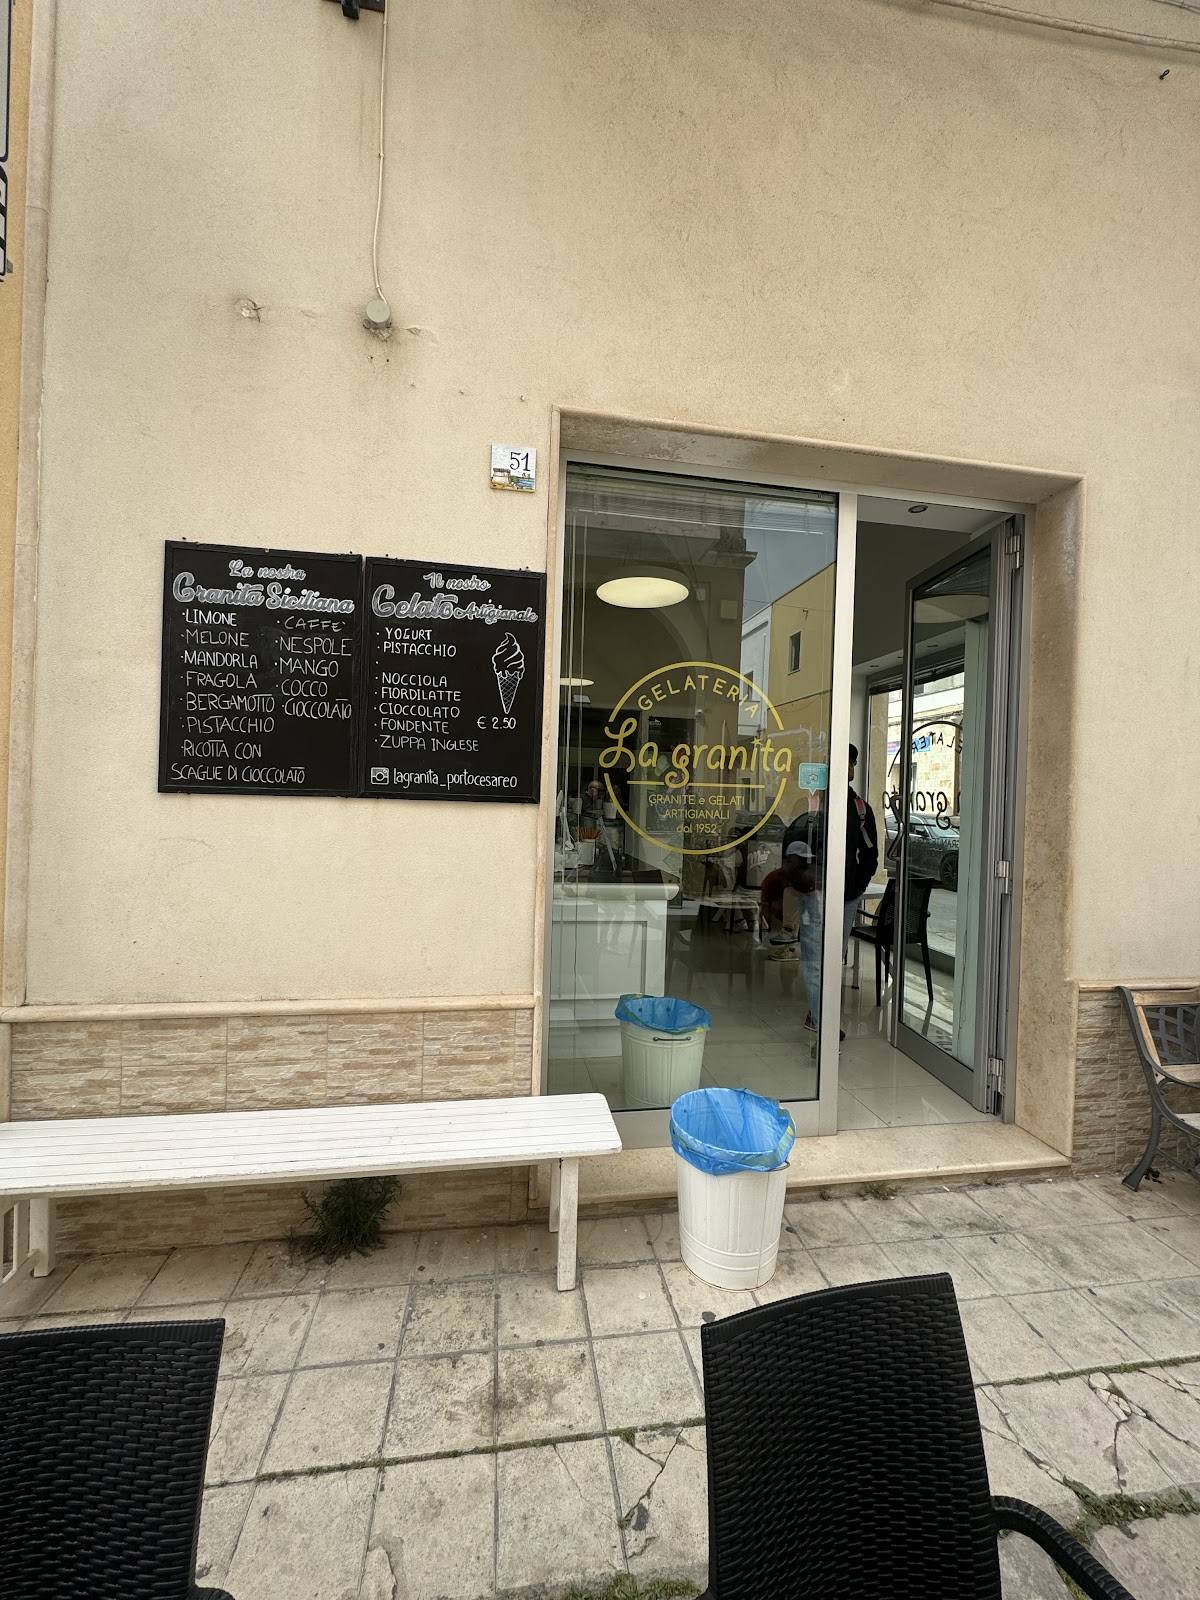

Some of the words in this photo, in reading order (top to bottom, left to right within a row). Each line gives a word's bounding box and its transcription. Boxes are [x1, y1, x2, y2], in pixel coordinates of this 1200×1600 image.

[510, 451, 531, 471] 51
[228, 559, 255, 578] La
[257, 563, 307, 581] nostra
[172, 571, 265, 606] Granita
[265, 582, 355, 613] Siciliana
[446, 575, 492, 591] nostro
[371, 583, 459, 619] Gelato
[453, 599, 539, 625] Artigianale
[185, 608, 238, 627] LIMONE
[186, 628, 250, 648] MELONE
[385, 627, 433, 641] YOGURT
[279, 636, 353, 657] NESPOLE
[383, 641, 457, 657] PISTACCHIO
[184, 650, 258, 669] MANDORLA
[279, 656, 339, 678] MANGO
[186, 671, 258, 689] FRAGOLA
[281, 678, 328, 697] COCCO
[382, 672, 448, 688] NOCCIOLA
[186, 691, 275, 713] BERGAMOTTO
[381, 686, 462, 702] FIORDILATTE
[638, 675, 761, 719] GELATERIA
[284, 698, 352, 720] CIOCCOLATO
[379, 702, 460, 718] CIOCCOLATO
[187, 715, 275, 734] PISTACCHIO
[381, 717, 450, 735] FONDENTE
[476, 715, 487, 730] €
[491, 716, 517, 730] 2.50
[183, 739, 229, 758] RICOTTA
[234, 742, 262, 759] CON
[379, 734, 426, 750] ZUPPA
[431, 737, 479, 752] INGLESE
[598, 717, 659, 773] La
[664, 738, 793, 789] granita
[170, 762, 224, 780] SCAGLIE
[227, 765, 238, 781] DI
[242, 766, 306, 784] CIOCCOLATO
[393, 767, 518, 790] lagranita_portocesareo
[649, 794, 696, 805] GRANITE
[699, 797, 706, 805] e
[708, 795, 745, 806] GELATI
[664, 808, 730, 820] ARTIGIANALI
[676, 824, 693, 833] dal
[695, 823, 717, 834] 1952
